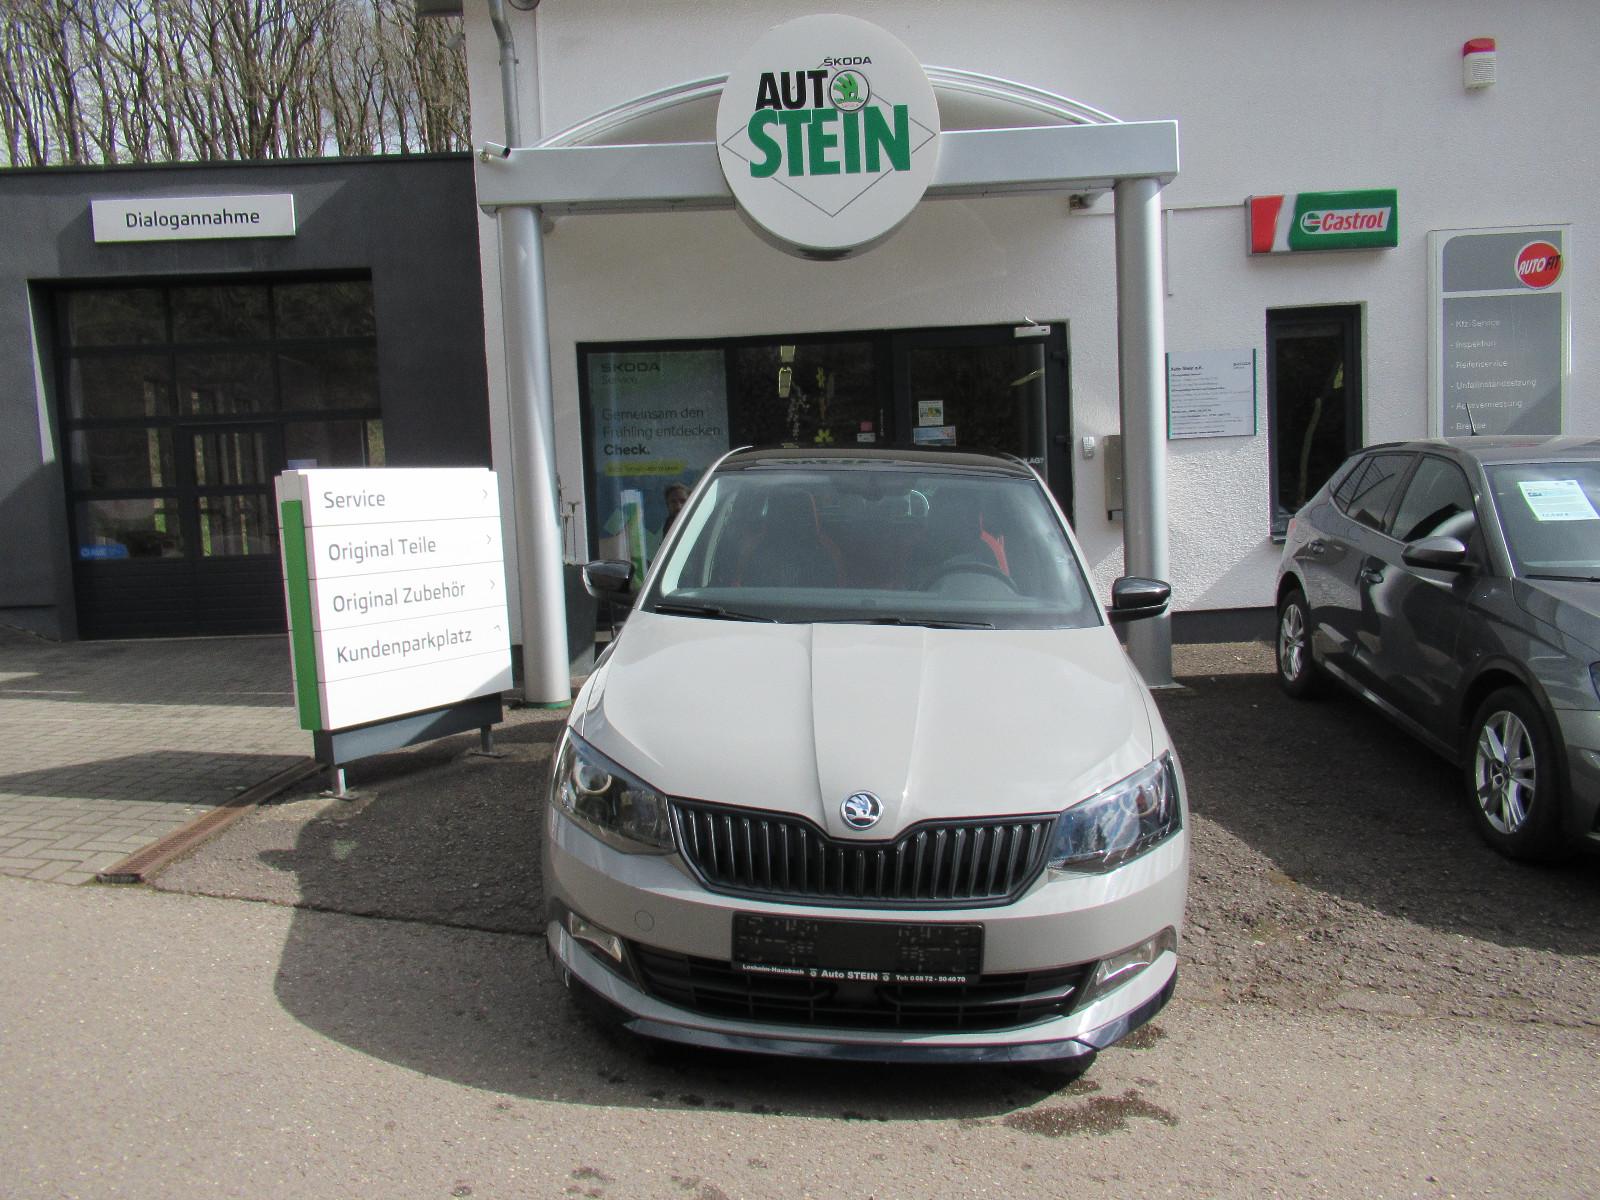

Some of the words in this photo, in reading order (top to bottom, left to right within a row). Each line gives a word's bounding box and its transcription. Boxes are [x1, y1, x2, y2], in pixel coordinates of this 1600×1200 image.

[747, 104, 911, 179] STEIN
[125, 208, 260, 230] Dialogannahme
[1321, 210, 1384, 232] Castrol
[680, 408, 704, 419] den
[655, 424, 721, 438] entdecken
[604, 443, 651, 456] Check.
[324, 489, 386, 508] Service
[328, 538, 394, 564] Original
[398, 536, 437, 555] Teile
[333, 588, 398, 614] Original
[403, 580, 466, 604] Zubehör
[337, 629, 473, 664] Kundenparkplatz
[821, 969, 845, 979] Auto
[847, 971, 878, 981] STEIN
